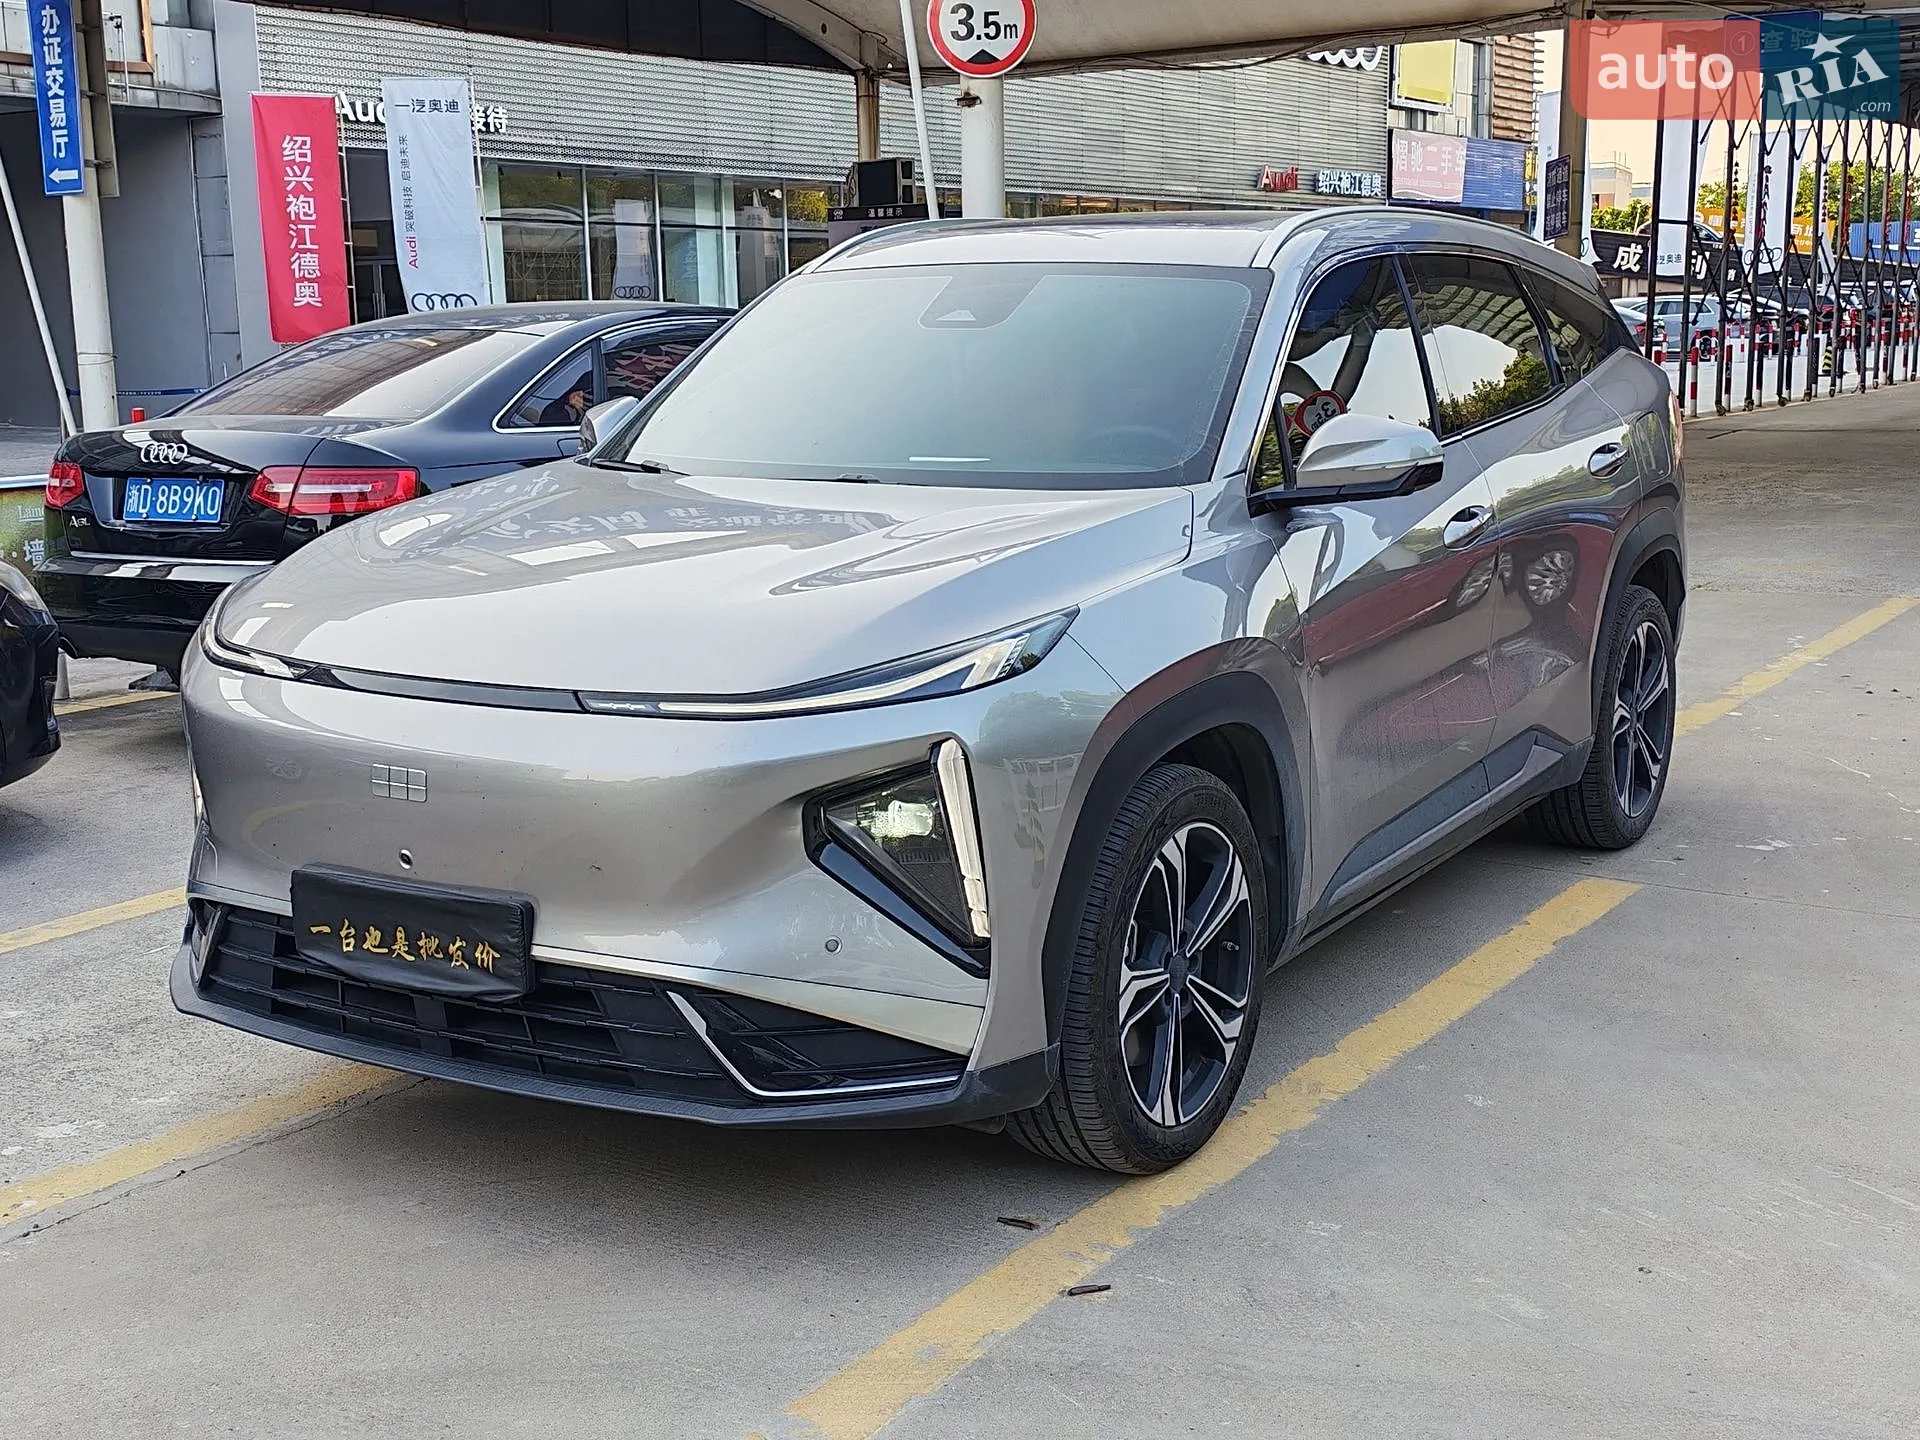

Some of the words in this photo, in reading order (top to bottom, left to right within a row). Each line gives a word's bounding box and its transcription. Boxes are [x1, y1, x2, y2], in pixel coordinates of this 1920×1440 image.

[950, 3, 1018, 41] 3.5m
[41, 4, 69, 159] 办证交易厅
[394, 98, 461, 114] 一汽奥迪
[399, 134, 412, 181] 启迪未来
[1258, 164, 1298, 191] Audi
[1318, 169, 1382, 197] 绍兴袍江德奥
[282, 135, 323, 307] 绍兴袍江德奥
[402, 186, 416, 232] 突破科技
[407, 236, 419, 269] Audi
[1613, 243, 1643, 272] 成
[1657, 253, 1682, 264] 汽奥迪
[310, 918, 501, 973] 一台也是批发价
